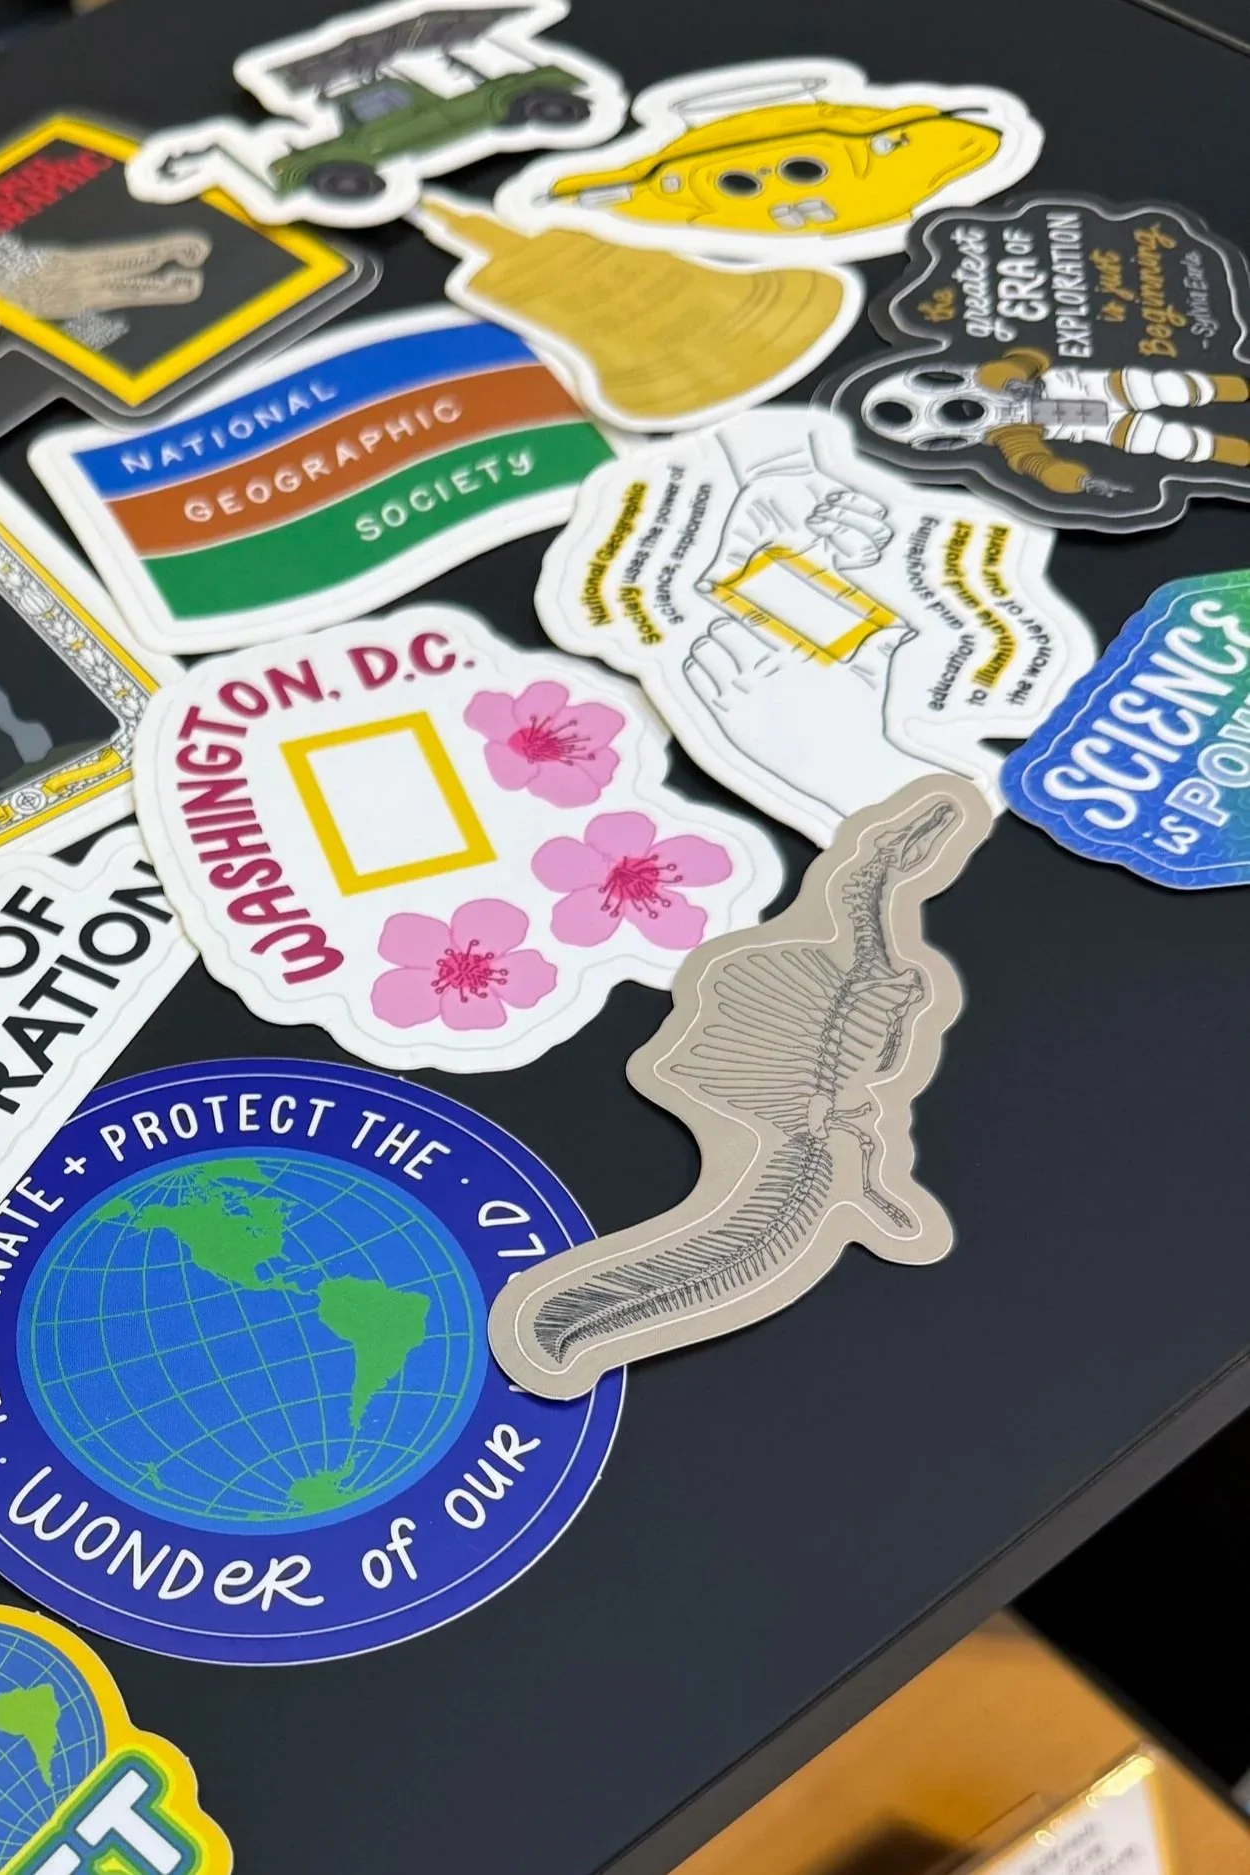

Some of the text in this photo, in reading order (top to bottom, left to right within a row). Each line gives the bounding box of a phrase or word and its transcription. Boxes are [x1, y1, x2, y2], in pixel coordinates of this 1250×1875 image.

[951, 225, 1017, 342] greatest
[996, 226, 1048, 322] ERA OF
[1046, 212, 1093, 358] EXPLORATION
[1089, 249, 1135, 301] just
[120, 377, 339, 475] NATIONAL
[183, 396, 463, 522] GEOGRAPHIC
[666, 464, 687, 481] of
[639, 526, 663, 549] the
[655, 480, 681, 526] power
[671, 483, 712, 561] exploration
[581, 482, 647, 627] National Geographic
[623, 549, 650, 584] uses
[904, 515, 976, 711] education and storytelling
[941, 520, 1016, 707] to illuminate and protect
[983, 523, 1053, 706] the wonder of our world
[175, 631, 477, 986] WASHINGTON, D.C.
[1142, 813, 1200, 856] is
[100, 1093, 337, 1164] PROTECT
[350, 1110, 452, 1185] THE
[360, 1516, 420, 1590] of
[442, 1422, 543, 1531] OUR
